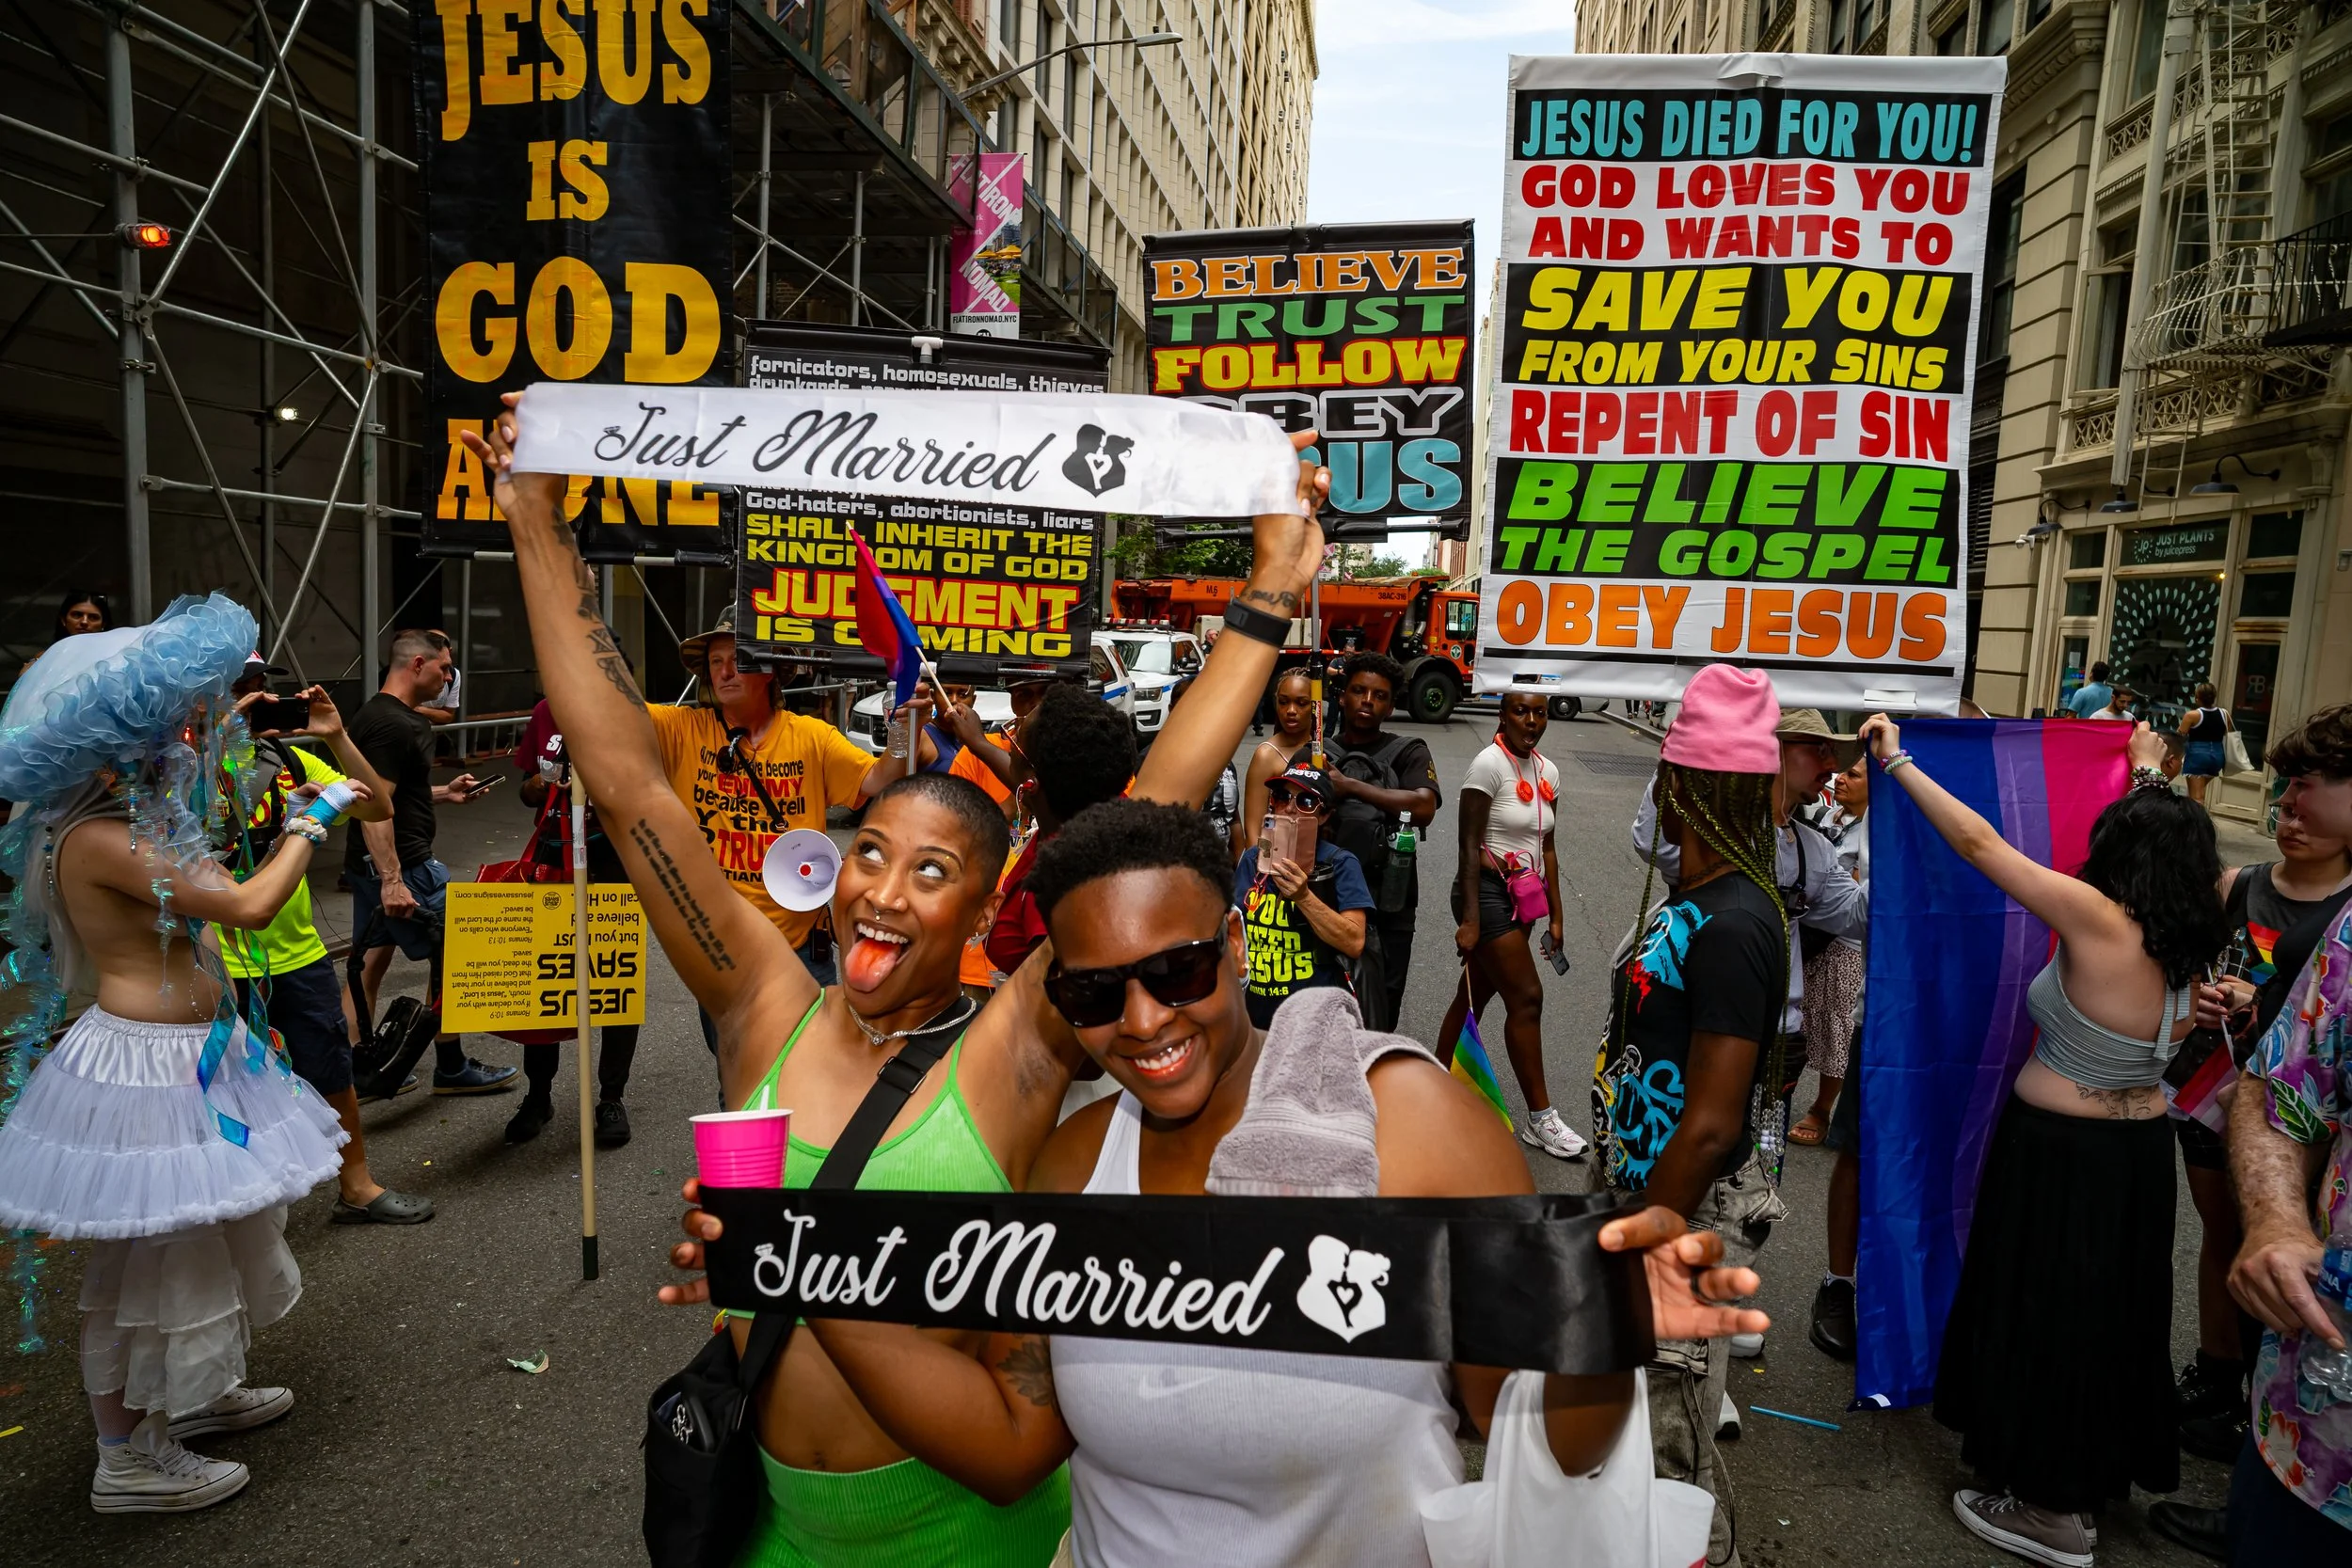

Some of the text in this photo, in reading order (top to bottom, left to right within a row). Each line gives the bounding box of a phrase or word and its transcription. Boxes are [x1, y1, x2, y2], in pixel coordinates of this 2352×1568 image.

[435, 0, 712, 141] JESUS
[1523, 98, 1977, 163] JESUS DIED FOR YOU!
[526, 139, 610, 221] IS
[1521, 163, 1970, 216] GOD LOVES YOU
[1528, 214, 1954, 266] AND WANTS TO
[959, 257, 1009, 312] NOMAD
[1151, 246, 1466, 301] BELIEVE
[436, 256, 721, 384] GOD
[952, 315, 1017, 324] FLATIRONNOMAD.NYC
[1153, 295, 1465, 341] TRUST
[1521, 267, 1954, 338] SAVE YOU
[751, 356, 877, 381] fornicators,
[882, 364, 1024, 391] homosexuals,
[1152, 337, 1467, 392] FOLLOW
[1518, 339, 1948, 390] FROM YOUR SINS
[1176, 387, 1464, 438] BEY
[1510, 389, 1949, 463] REPENT OF SIN
[595, 402, 1057, 492] Just Married
[746, 492, 883, 518] God-haters,
[890, 503, 1036, 528] abortionists,
[1042, 511, 1094, 531] liars
[1506, 461, 1947, 530] BELIEVE
[746, 514, 1092, 557] SHALL INHERIT THE
[1500, 527, 1950, 583] THE GOSPEL
[2155, 530, 2215, 546] JUST PLANTS
[944, 551, 995, 574] OF
[1005, 556, 1088, 580] GOD
[755, 617, 1072, 657] IS CMING
[1496, 580, 1947, 661] OBEY JESUS
[697, 768, 717, 783] your
[766, 759, 803, 777] become
[693, 784, 806, 816] because tell
[730, 814, 788, 833] the
[571, 913, 639, 926] believe ad
[603, 894, 617, 902] on
[621, 894, 640, 906] call
[554, 929, 639, 945] but you UST
[1248, 952, 1313, 983] ESUS
[539, 988, 637, 1017] JESUS
[753, 1208, 1284, 1336] Just Married
